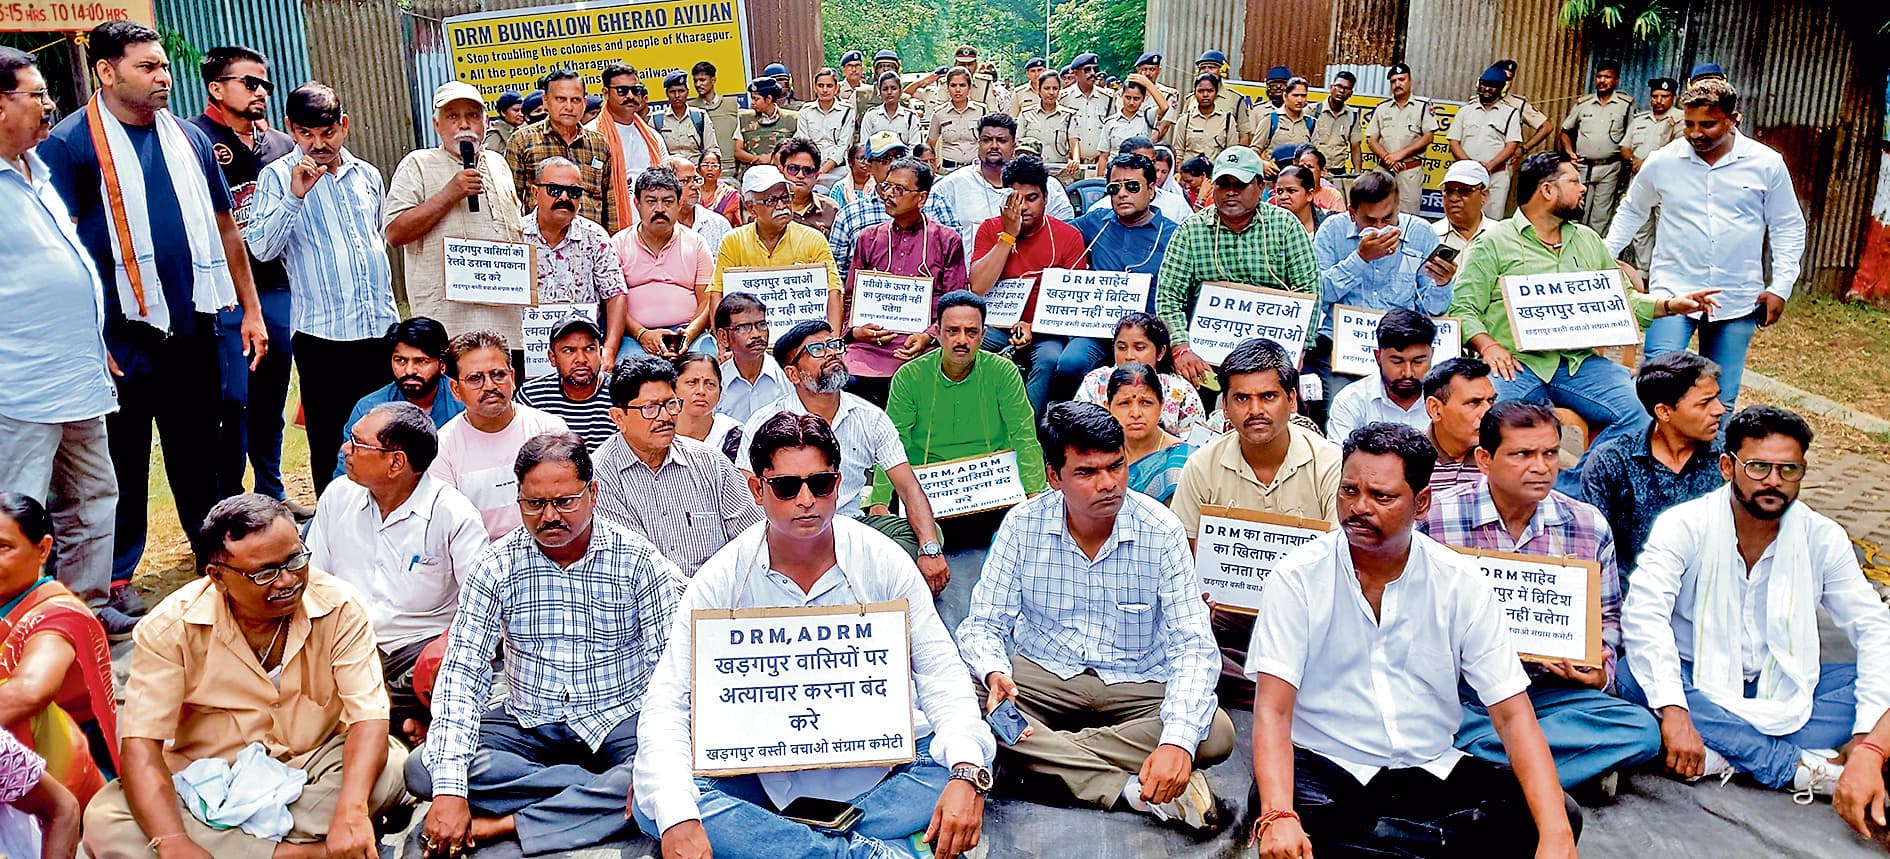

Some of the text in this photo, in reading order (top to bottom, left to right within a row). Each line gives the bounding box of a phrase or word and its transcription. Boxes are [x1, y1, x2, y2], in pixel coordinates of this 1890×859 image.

[50, 3, 68, 21] TO
[71, 3, 104, 21] 14:00
[454, 2, 732, 47] DRM BUNGALOW GHERAO AVIJAN
[467, 30, 733, 65] Stop troubling the colonies and people of Kharagpur.
[470, 69, 485, 81] All
[488, 67, 506, 79] the
[510, 63, 547, 79] people
[550, 61, 560, 71] of
[1062, 274, 1096, 285] DRM
[1519, 274, 1611, 297] DRM हटाओ
[814, 288, 827, 298] का
[1094, 288, 1104, 302] में
[1045, 304, 1078, 316] शासन
[1209, 296, 1302, 319] DRM हटाओ
[1516, 303, 1575, 320] खड़गपुर
[1197, 315, 1254, 338] खड़गपुर
[1344, 315, 1377, 328] DRM
[1205, 524, 1240, 538] DRM
[1243, 528, 1261, 541] का
[1213, 543, 1230, 556] का
[1232, 542, 1278, 562] खिलाफ
[1220, 562, 1254, 578] जनता
[1517, 586, 1528, 602] में
[1505, 606, 1570, 626] नहीं चलेगा
[797, 622, 873, 643] ADRM
[714, 645, 889, 677] खड़गपुर वासियों पर
[719, 675, 888, 705] अत्याचार करना बंद
[788, 708, 821, 732] करे
[705, 746, 755, 762] खड़गपुर
[832, 738, 866, 754] संग्राम
[868, 733, 904, 750] कमेटी
